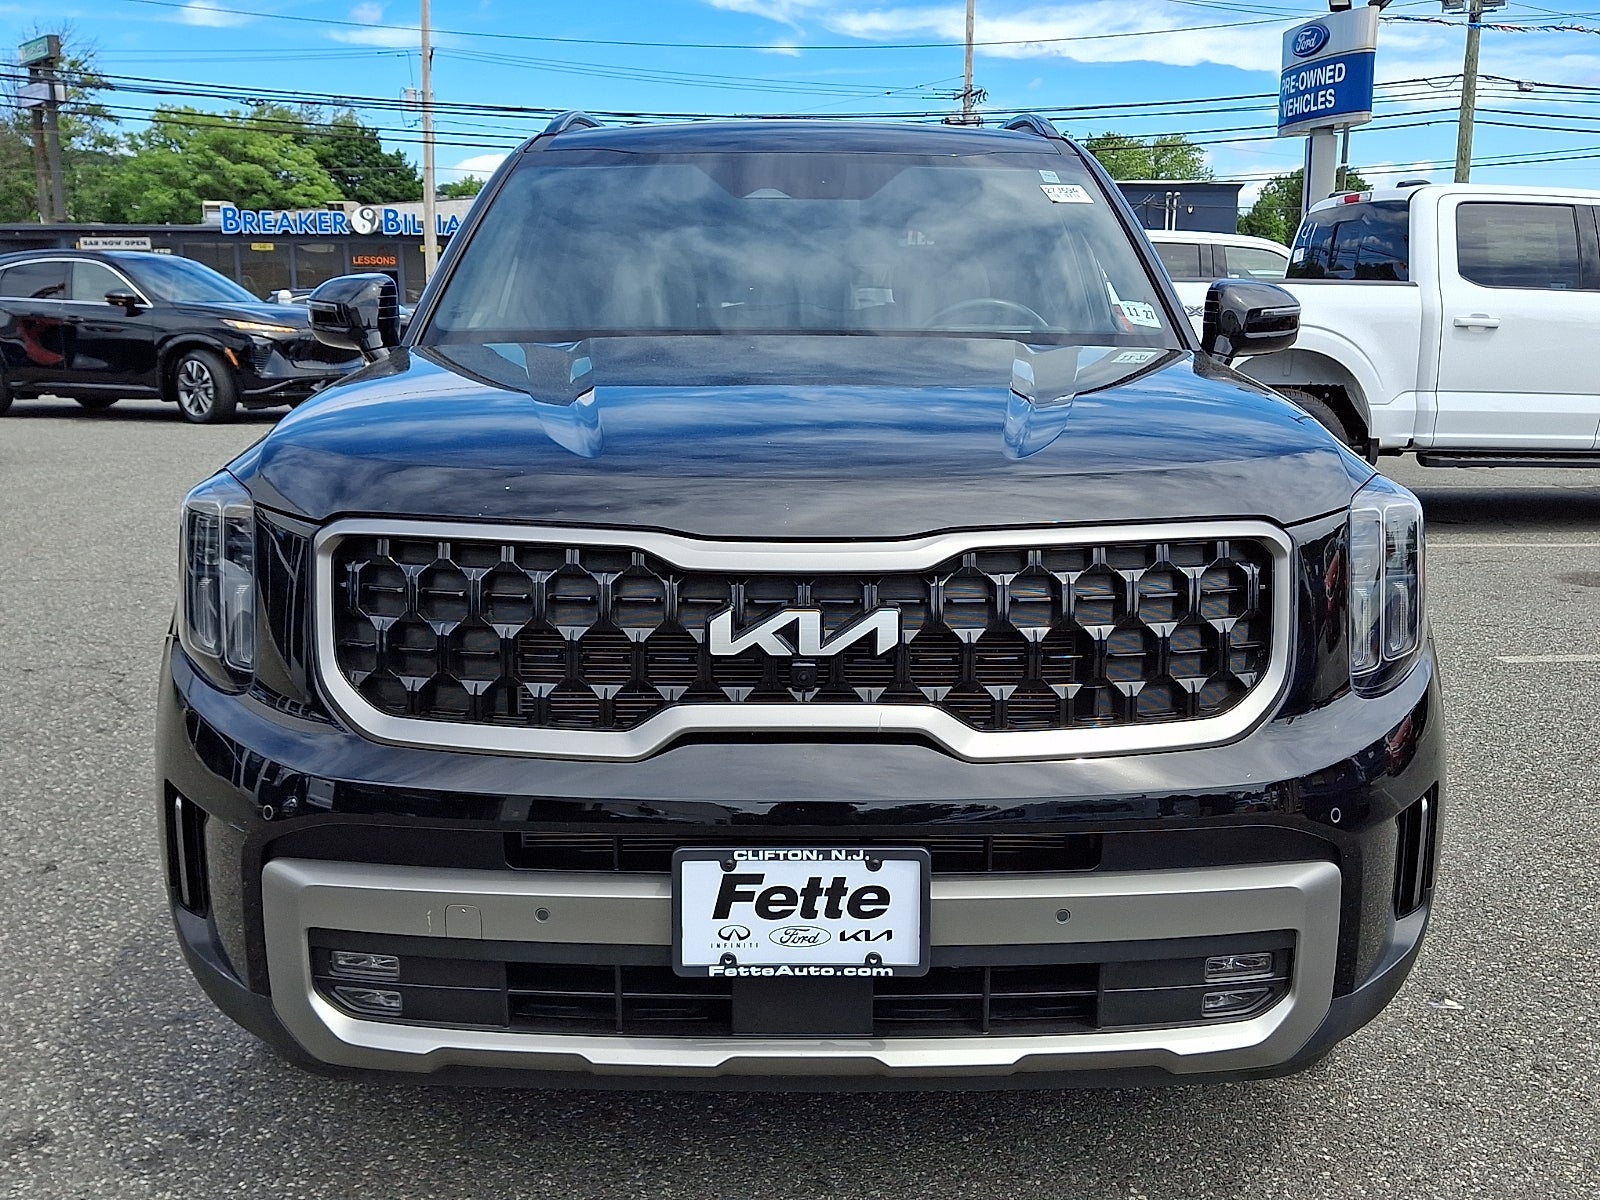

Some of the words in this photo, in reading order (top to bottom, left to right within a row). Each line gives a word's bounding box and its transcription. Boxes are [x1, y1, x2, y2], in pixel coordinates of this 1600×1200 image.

[1295, 30, 1318, 52] Ford
[1281, 62, 1346, 96] PRE-OWNED
[1282, 88, 1335, 118] VEHICLES
[221, 206, 351, 235] BREAKER
[383, 203, 463, 236] BILIA
[352, 256, 396, 265] LESSONS
[1142, 309, 1155, 320] 27
[709, 609, 900, 656] KIA
[733, 850, 823, 861] CLIFTON,
[831, 850, 870, 861] N.J.
[711, 873, 891, 920] Fette
[779, 928, 820, 944] Ford
[839, 929, 893, 942] KIA
[708, 965, 893, 977] FetteAuto.com
